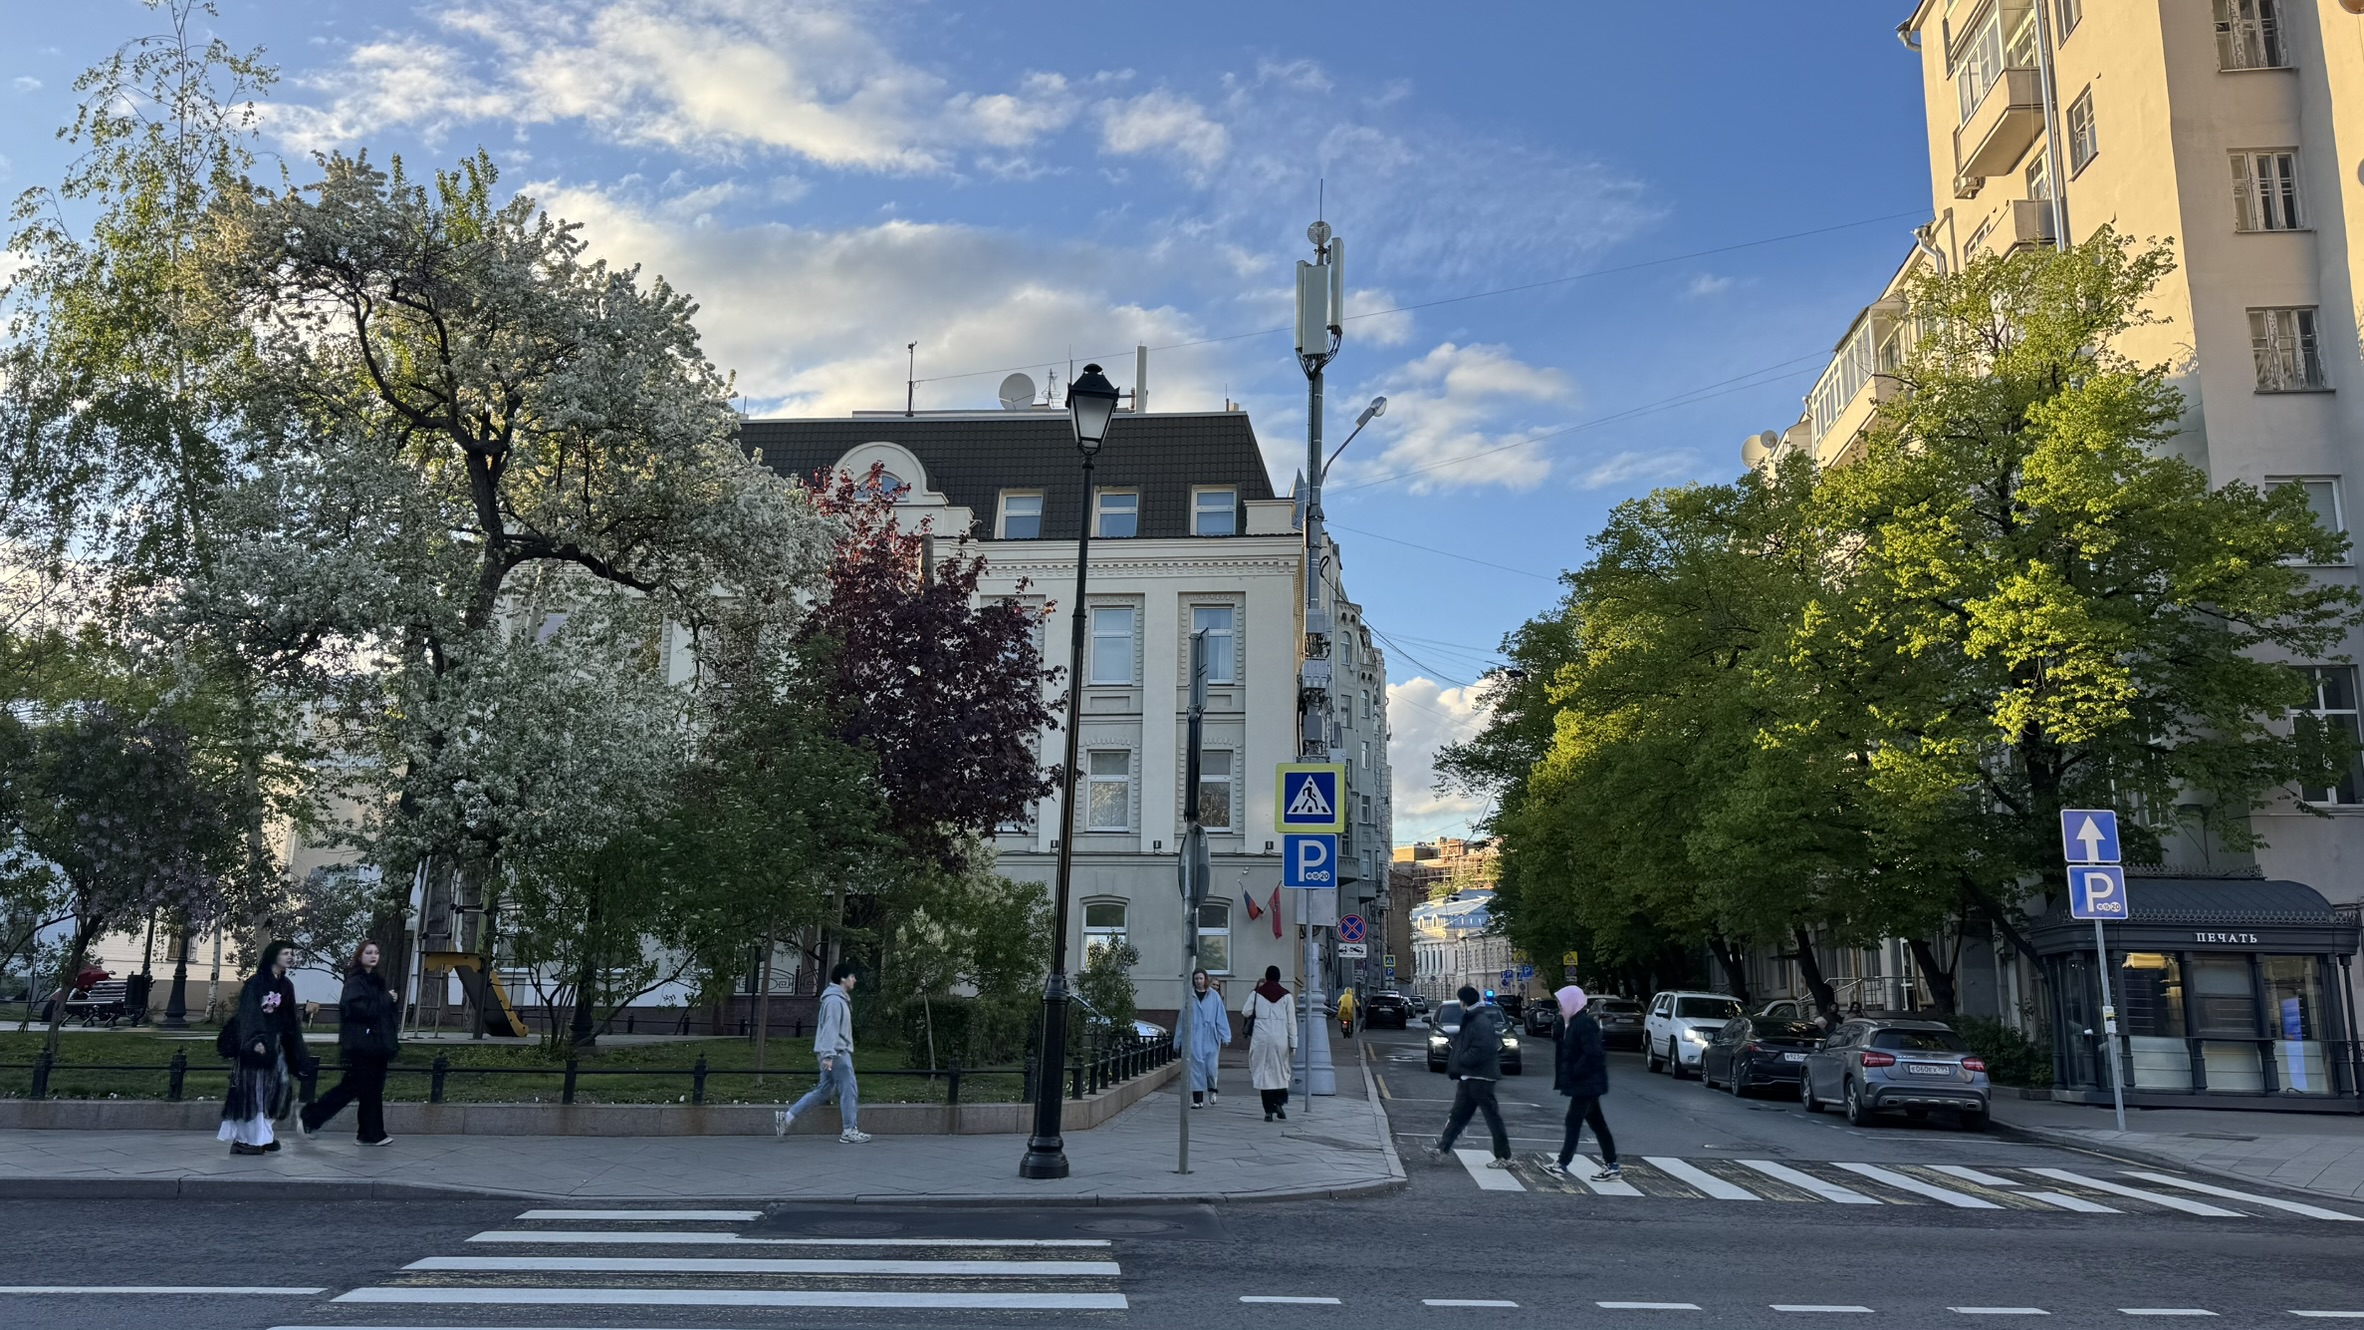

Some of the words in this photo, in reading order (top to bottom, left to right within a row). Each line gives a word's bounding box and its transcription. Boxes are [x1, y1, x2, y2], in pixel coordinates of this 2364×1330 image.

[1298, 840, 1327, 882] P
[1320, 872, 1329, 880] 20
[2084, 872, 2114, 912] P
[2111, 903, 2120, 911] 20
[2195, 932, 2258, 943] ПЕЧАТЬ
